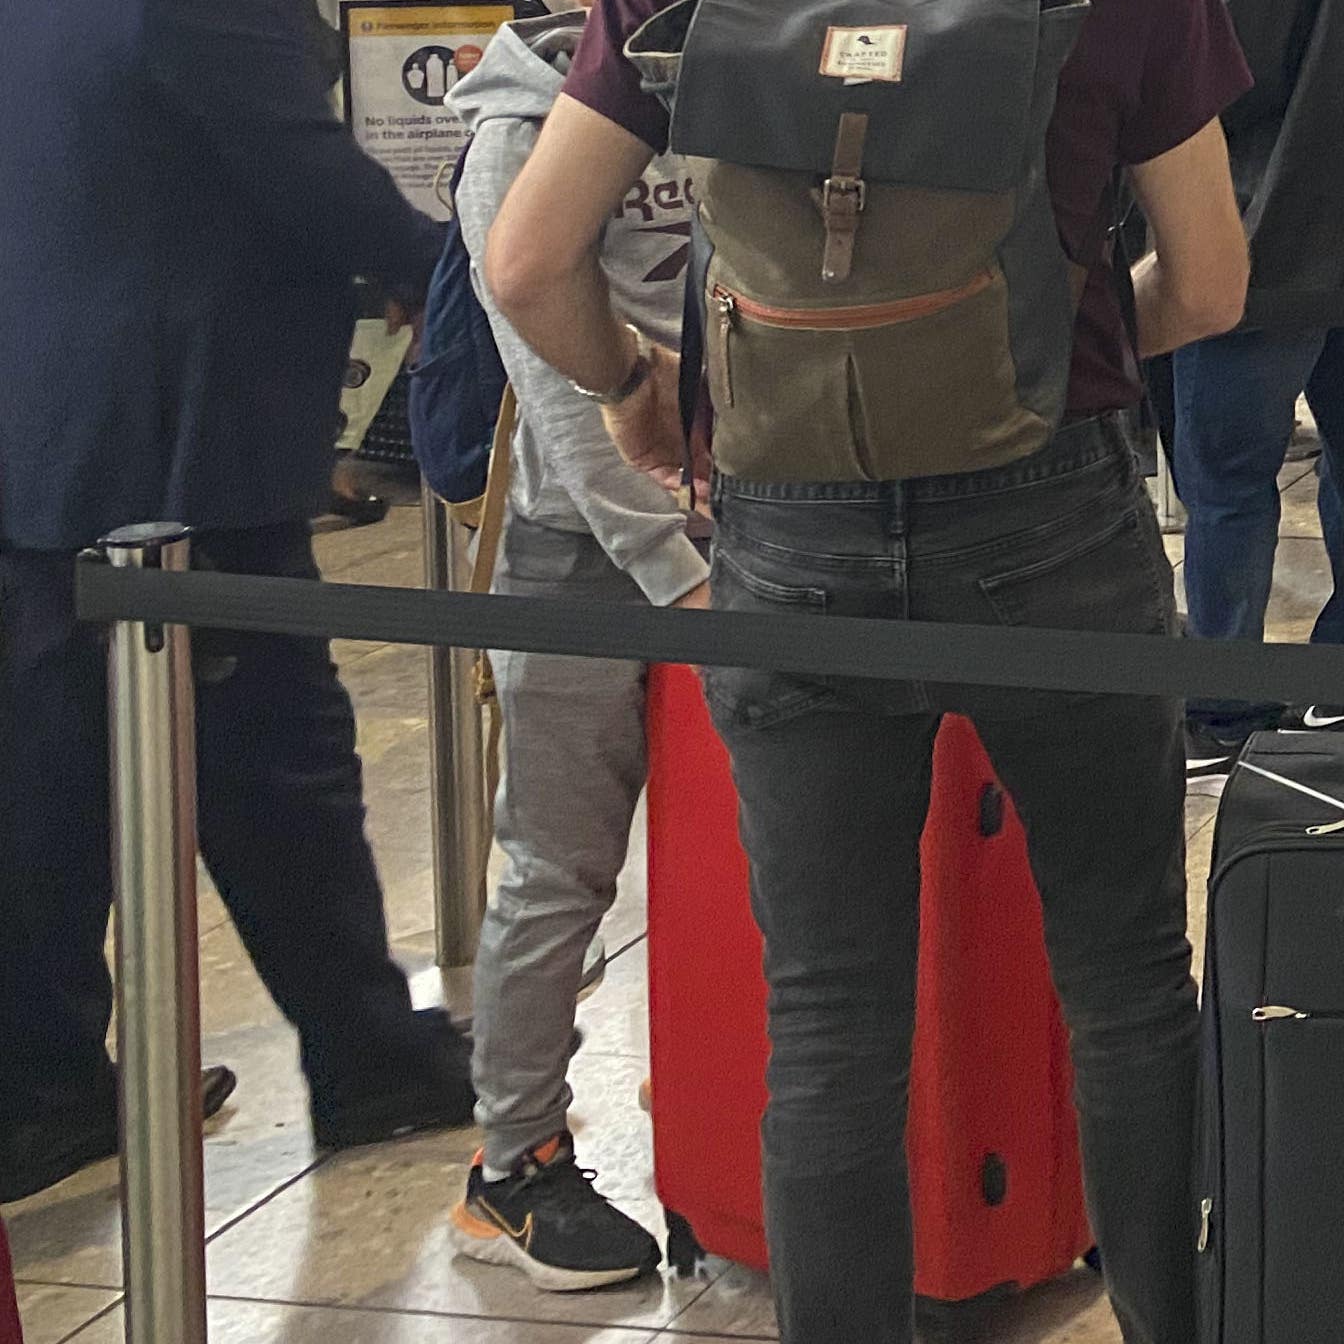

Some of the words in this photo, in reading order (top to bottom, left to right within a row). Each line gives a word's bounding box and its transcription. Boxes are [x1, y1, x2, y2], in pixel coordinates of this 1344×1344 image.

[364, 116, 385, 126] No
[388, 115, 432, 129] liquids
[382, 131, 406, 139] the
[407, 129, 461, 141] airplane
